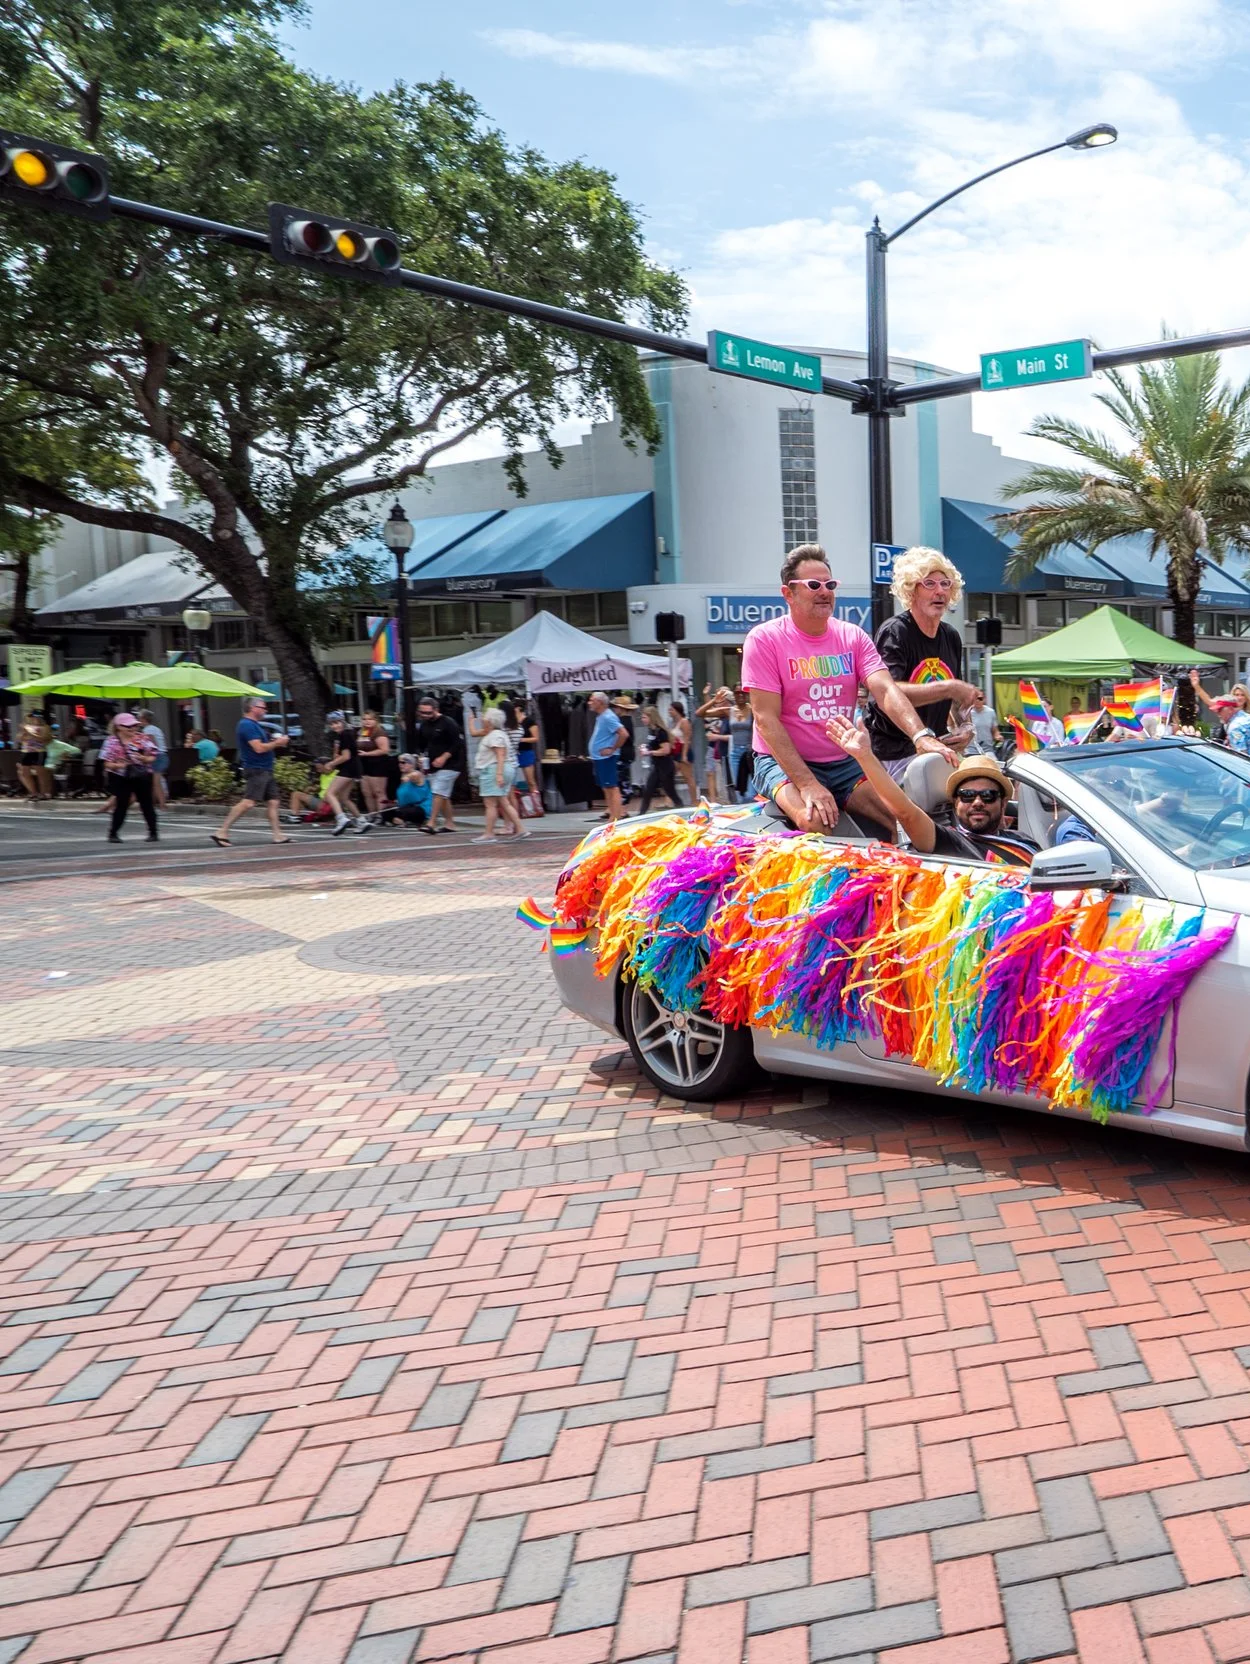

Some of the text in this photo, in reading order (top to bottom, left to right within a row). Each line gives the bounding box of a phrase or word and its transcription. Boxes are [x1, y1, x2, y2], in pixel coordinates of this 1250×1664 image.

[746, 349, 786, 374] Lemon
[792, 361, 814, 381] Ave
[1016, 353, 1069, 376] Main St
[446, 577, 498, 591] bluemercury
[1064, 577, 1108, 594] bluemercury
[706, 597, 872, 627] bluemury
[11, 648, 47, 656] SPEED
[15, 656, 44, 664] LIMIT
[17, 667, 43, 681] 15
[787, 652, 854, 680] PROUDLY
[541, 665, 618, 686] delighted
[797, 703, 853, 721] CLOSET
